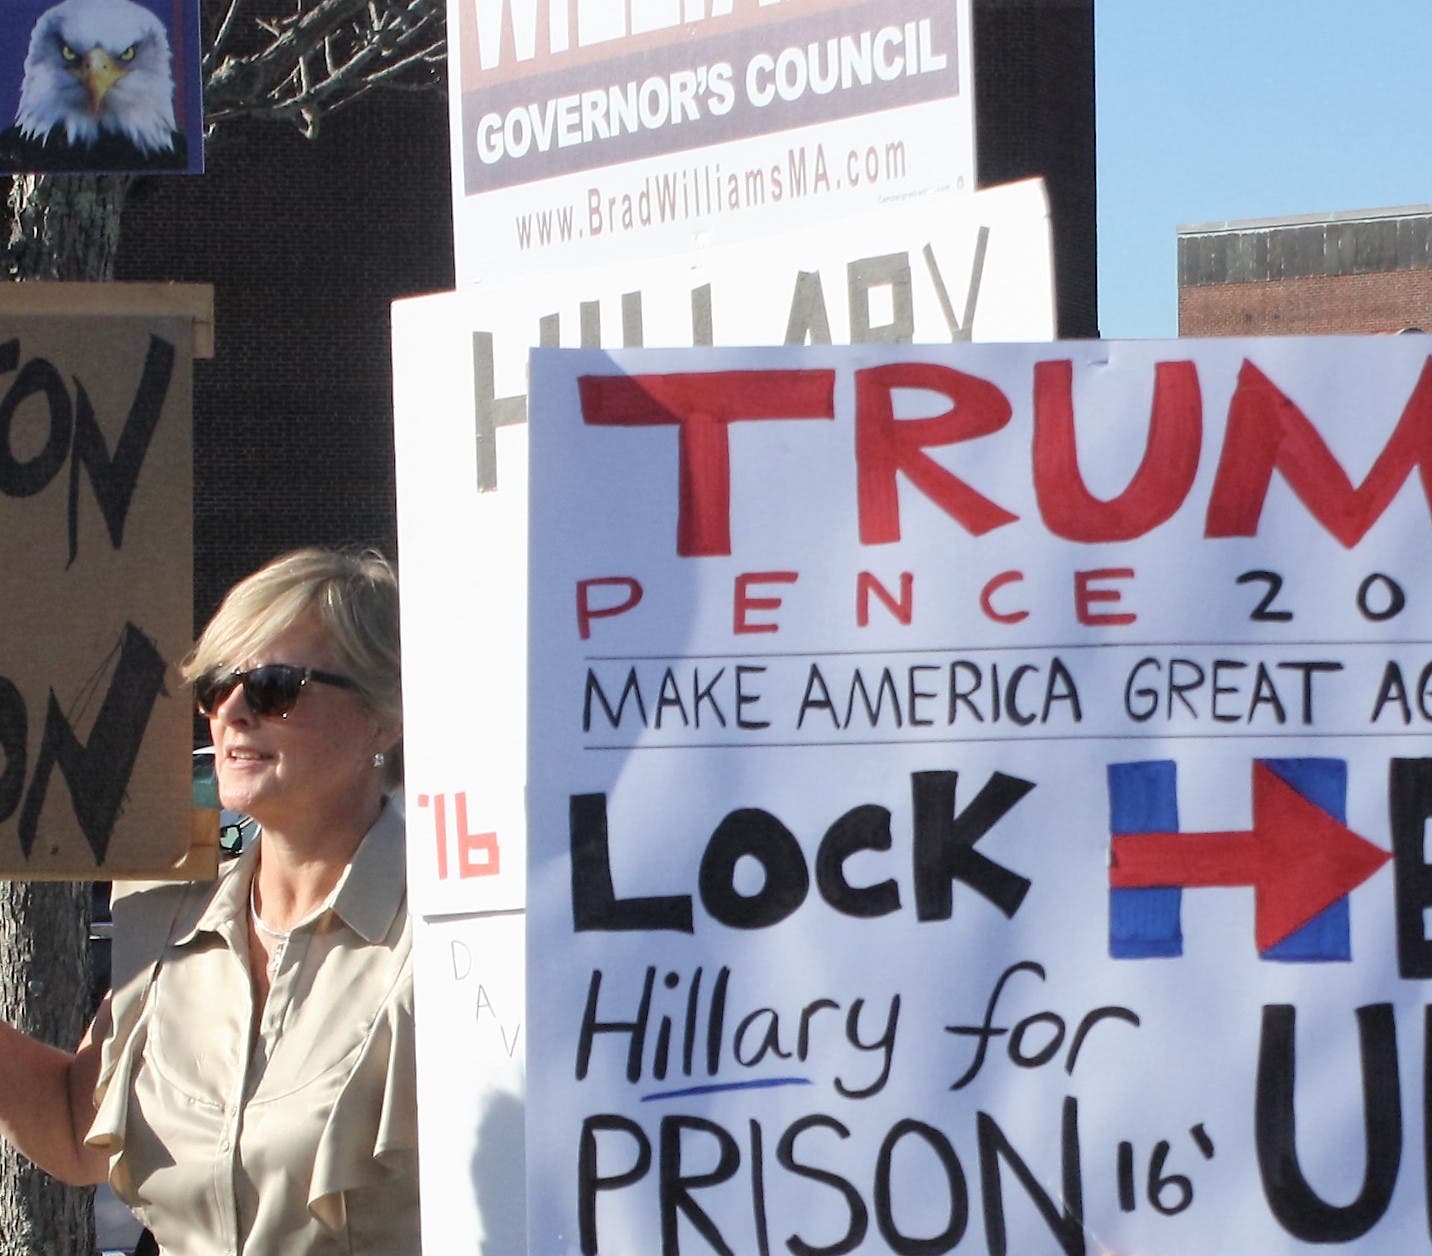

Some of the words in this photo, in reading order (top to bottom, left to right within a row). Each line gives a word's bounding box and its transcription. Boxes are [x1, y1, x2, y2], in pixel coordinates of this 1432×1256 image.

[477, 64, 736, 164] GOVERNOR'S
[745, 18, 947, 107] COUNCIL
[516, 138, 906, 251] www.BradWilliamsMA.com
[0, 333, 175, 571] ON
[576, 568, 1137, 639] PENCE
[582, 664, 771, 733] MAKE
[796, 656, 1083, 730] AMERICA
[1124, 657, 1344, 725] GREAT
[417, 792, 500, 880] '16
[569, 770, 1037, 933] LOCK
[576, 966, 900, 1099] Hillary
[944, 961, 1140, 1091] for
